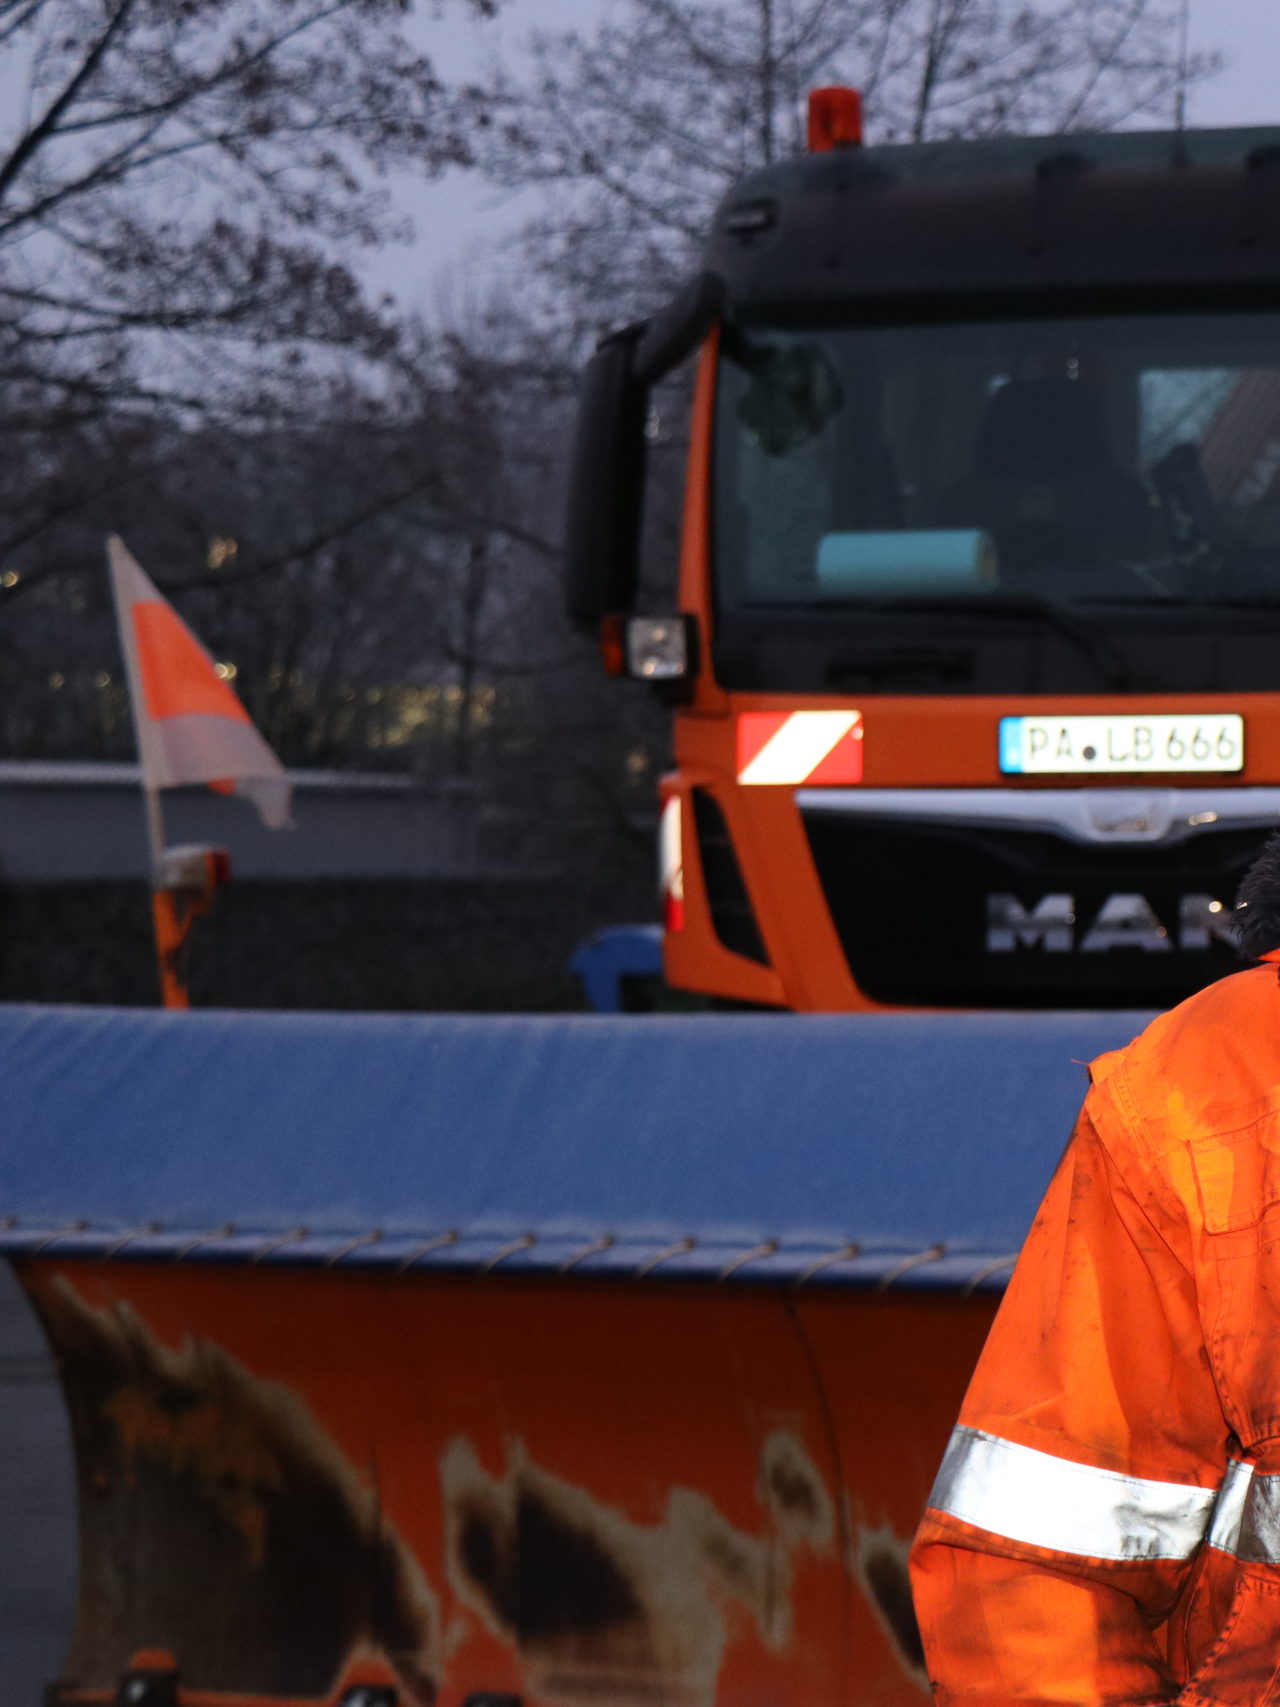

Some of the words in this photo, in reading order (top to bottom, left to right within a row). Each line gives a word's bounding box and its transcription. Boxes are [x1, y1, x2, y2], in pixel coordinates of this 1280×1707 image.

[1027, 727, 1073, 761] PA
[1106, 726, 1154, 762] LB
[1165, 726, 1236, 761] 666
